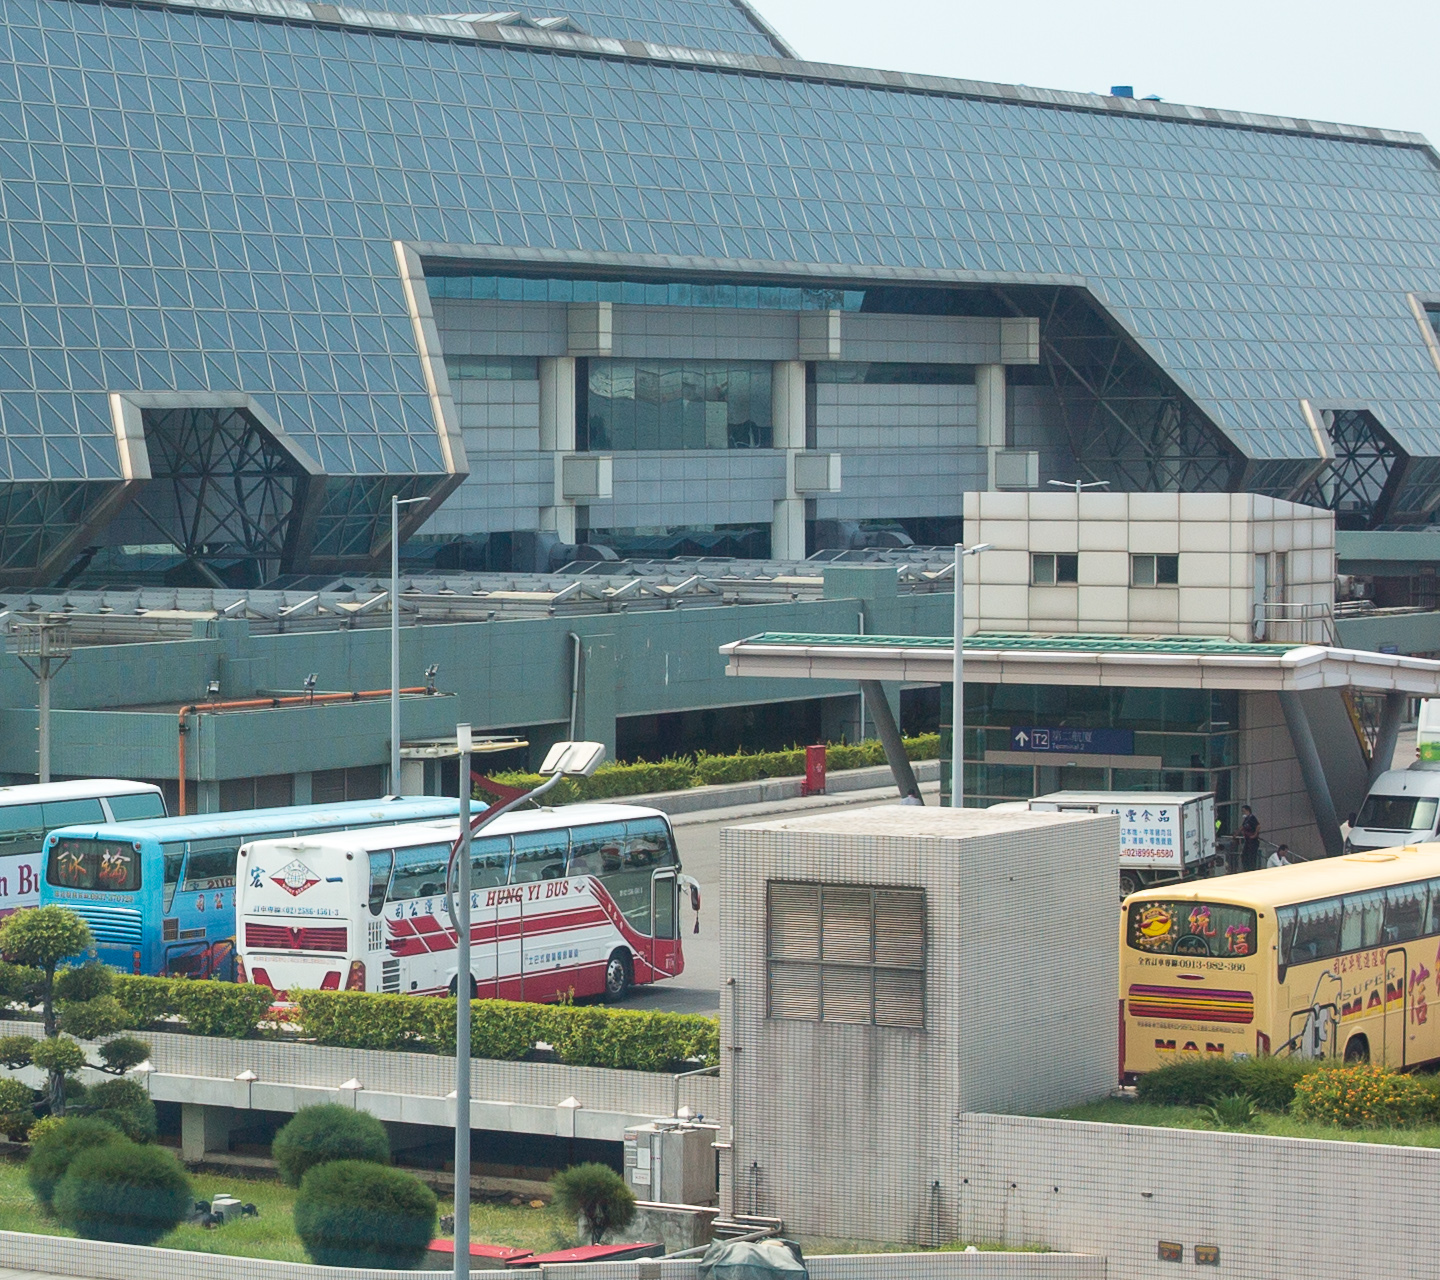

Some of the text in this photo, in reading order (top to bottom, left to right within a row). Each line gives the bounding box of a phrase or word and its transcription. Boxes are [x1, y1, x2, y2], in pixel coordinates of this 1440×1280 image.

[1033, 733, 1048, 745] T2
[486, 880, 570, 907] HUNG YI BUS
[1177, 946, 1207, 954] MAN
[1342, 967, 1396, 1001] SUPER
[1342, 978, 1403, 1022] MAN
[1155, 1039, 1224, 1054] MAN
